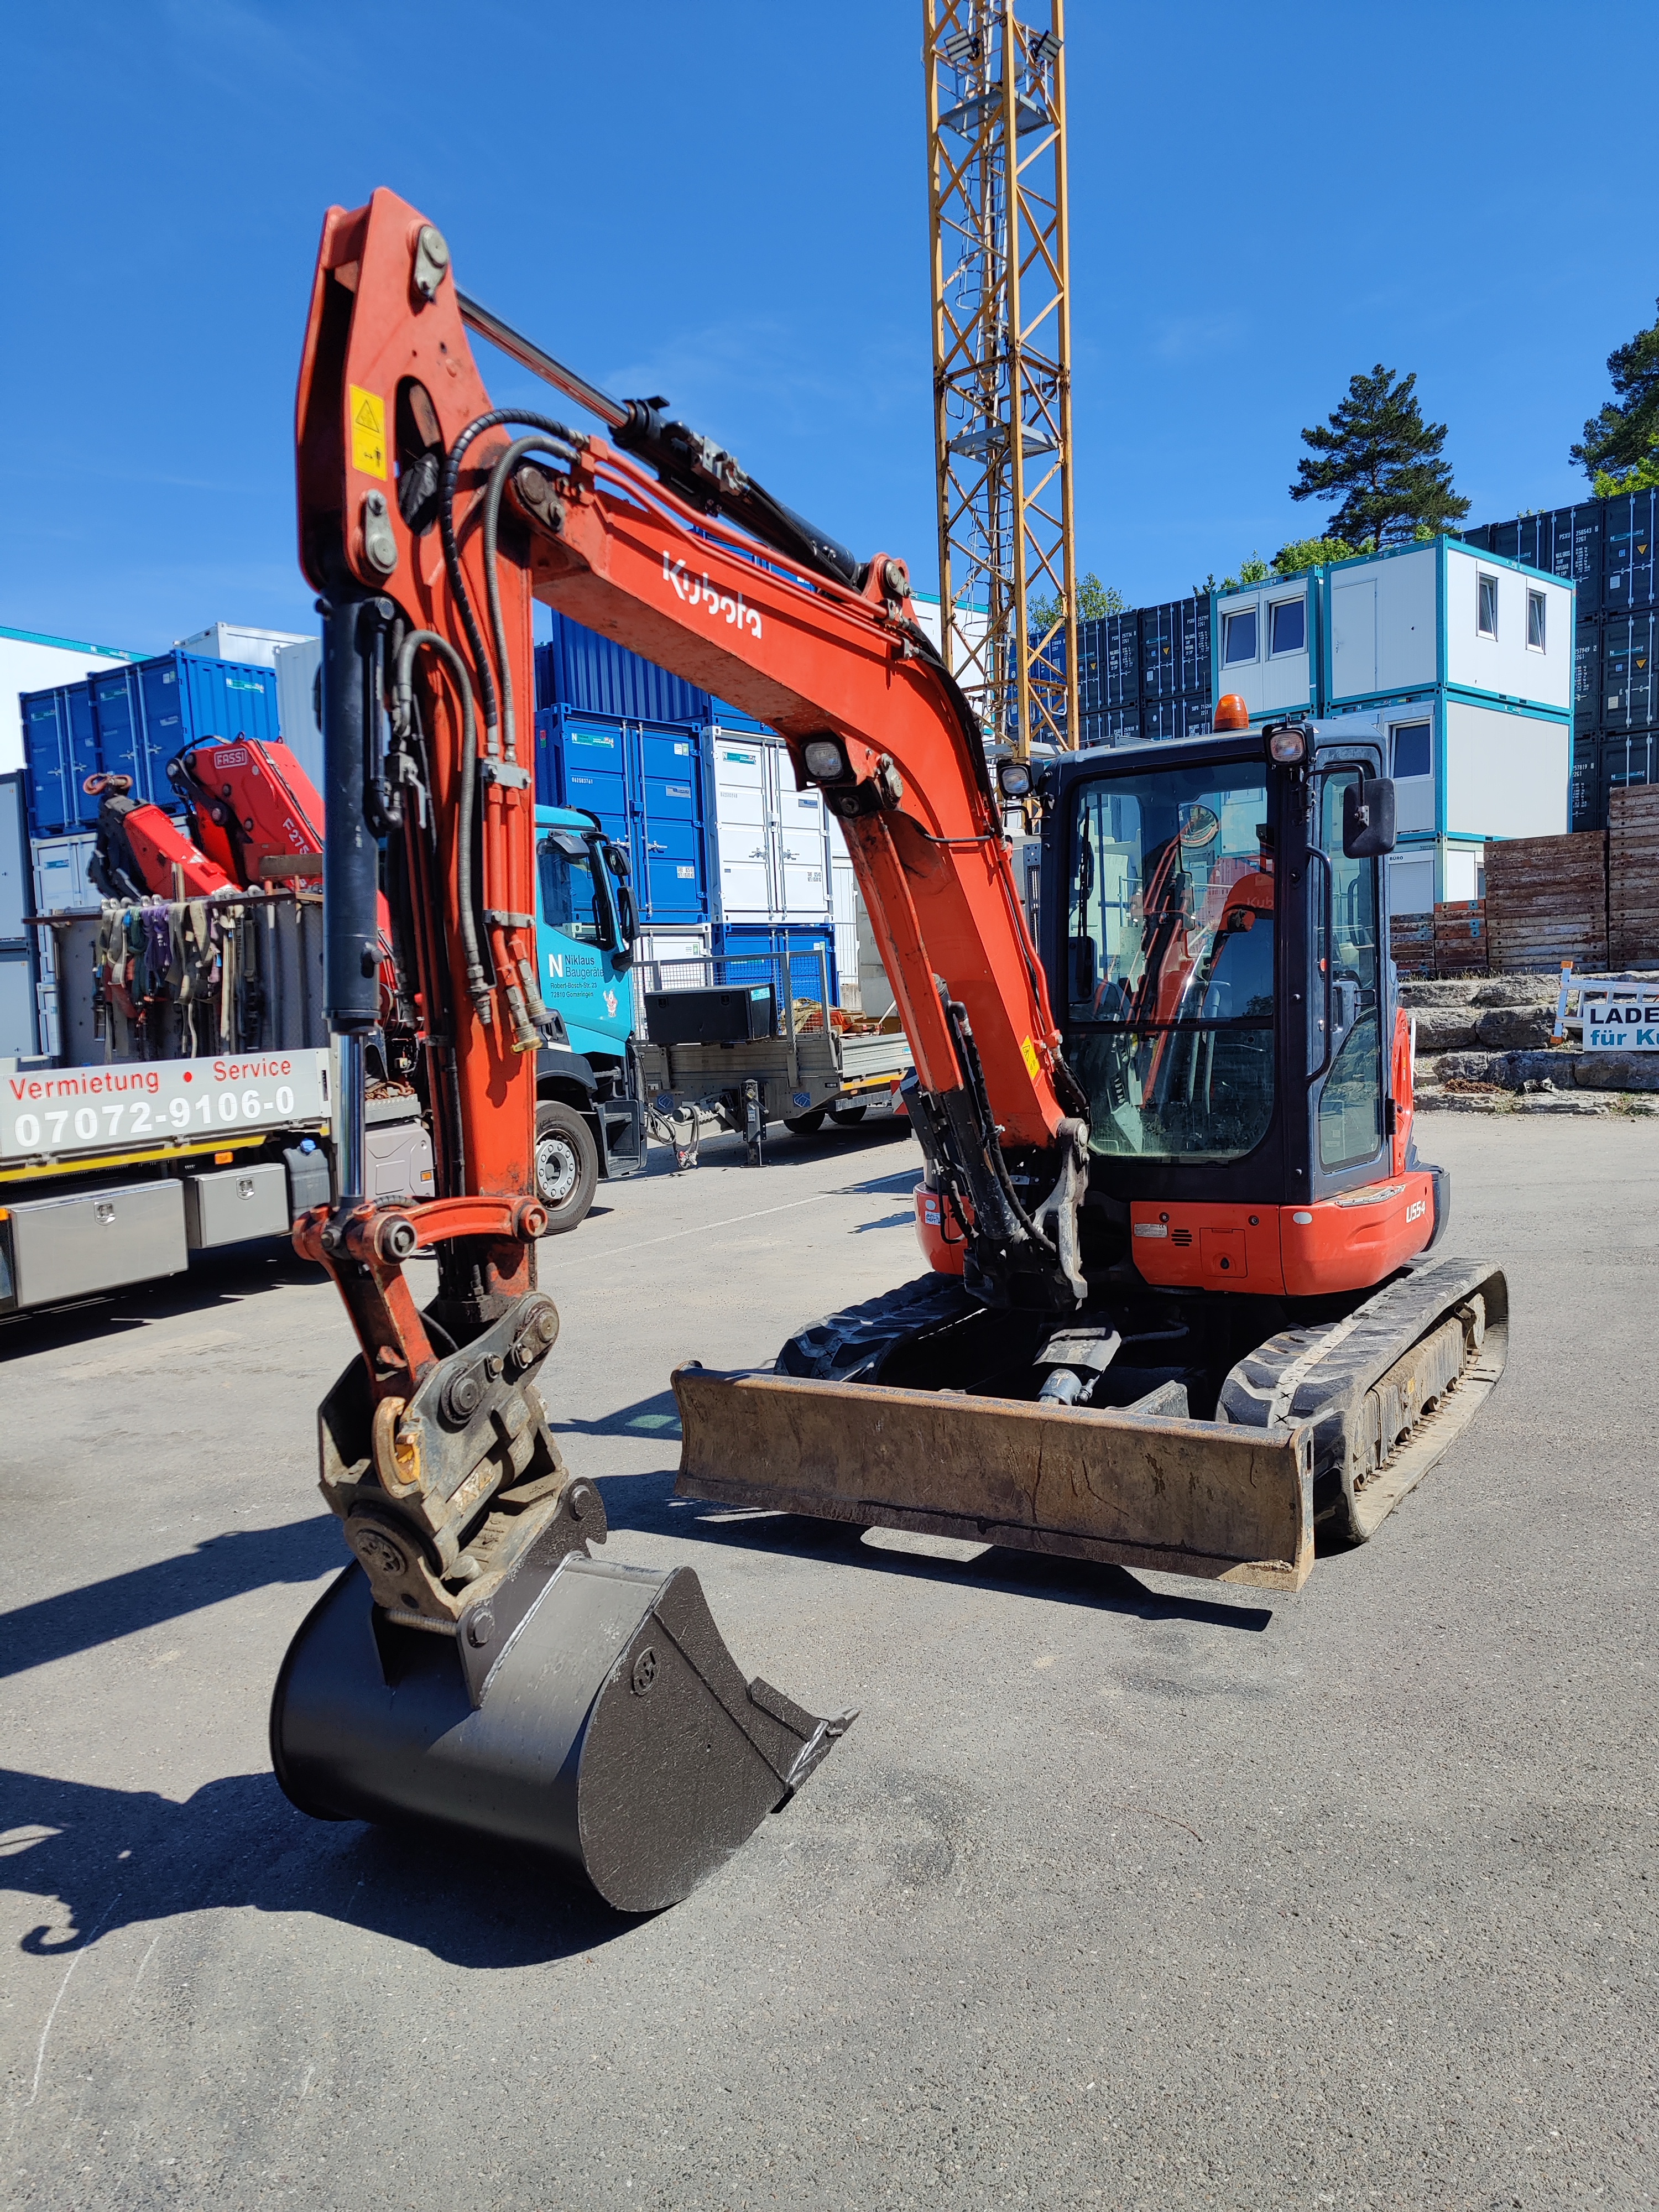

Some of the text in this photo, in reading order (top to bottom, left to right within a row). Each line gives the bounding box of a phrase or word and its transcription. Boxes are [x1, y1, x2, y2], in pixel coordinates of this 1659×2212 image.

[1575, 528, 1592, 536] 256543
[663, 550, 762, 639] Kubota
[217, 752, 244, 765] FASSI
[549, 954, 594, 977] N Niklaus
[566, 967, 604, 979] Baugeräte
[1590, 1029, 1659, 1046] für K
[9, 1058, 291, 1101] Vermietung Service
[14, 1086, 294, 1147] 07072-9106-0
